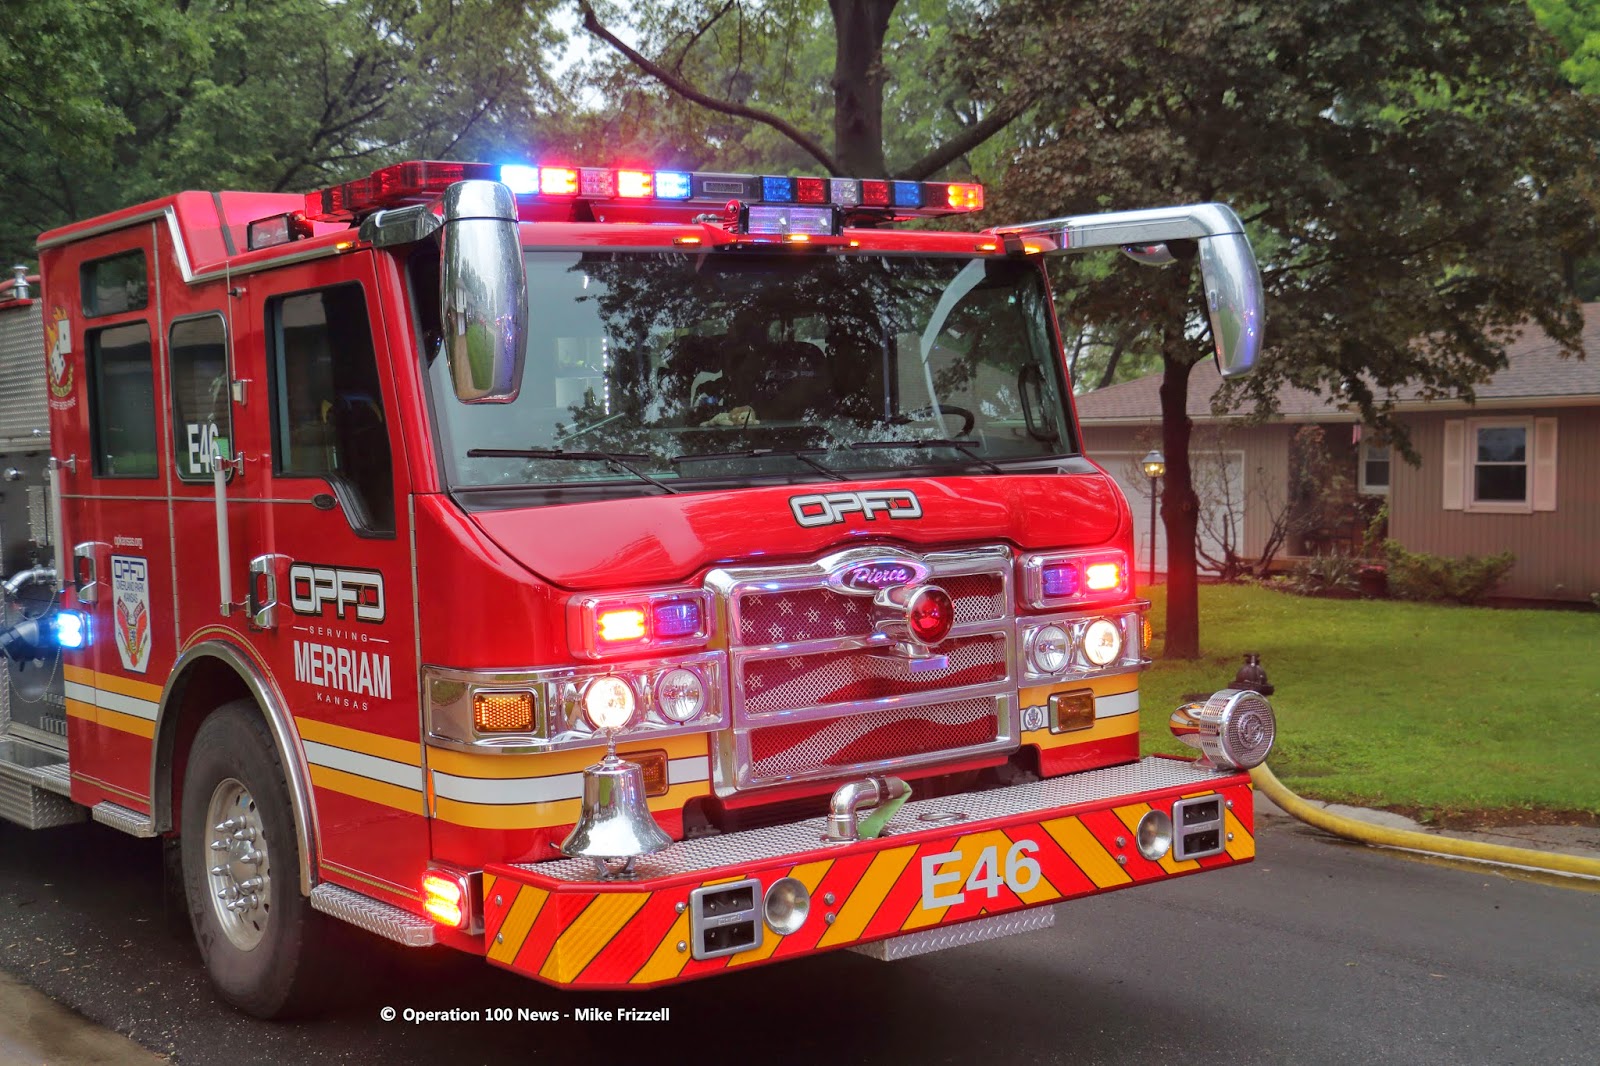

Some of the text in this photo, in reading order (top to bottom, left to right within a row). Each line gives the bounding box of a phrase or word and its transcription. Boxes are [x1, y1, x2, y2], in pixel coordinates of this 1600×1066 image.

[187, 423, 220, 474] E46
[789, 489, 923, 528] OPFD
[114, 559, 145, 581] OPFD
[852, 567, 908, 590] Pierce
[290, 562, 386, 623] OPFD
[308, 625, 368, 642] SERVING
[293, 640, 392, 700] MERRIAM
[316, 692, 368, 711] KANSAS
[921, 839, 1041, 910] E46
